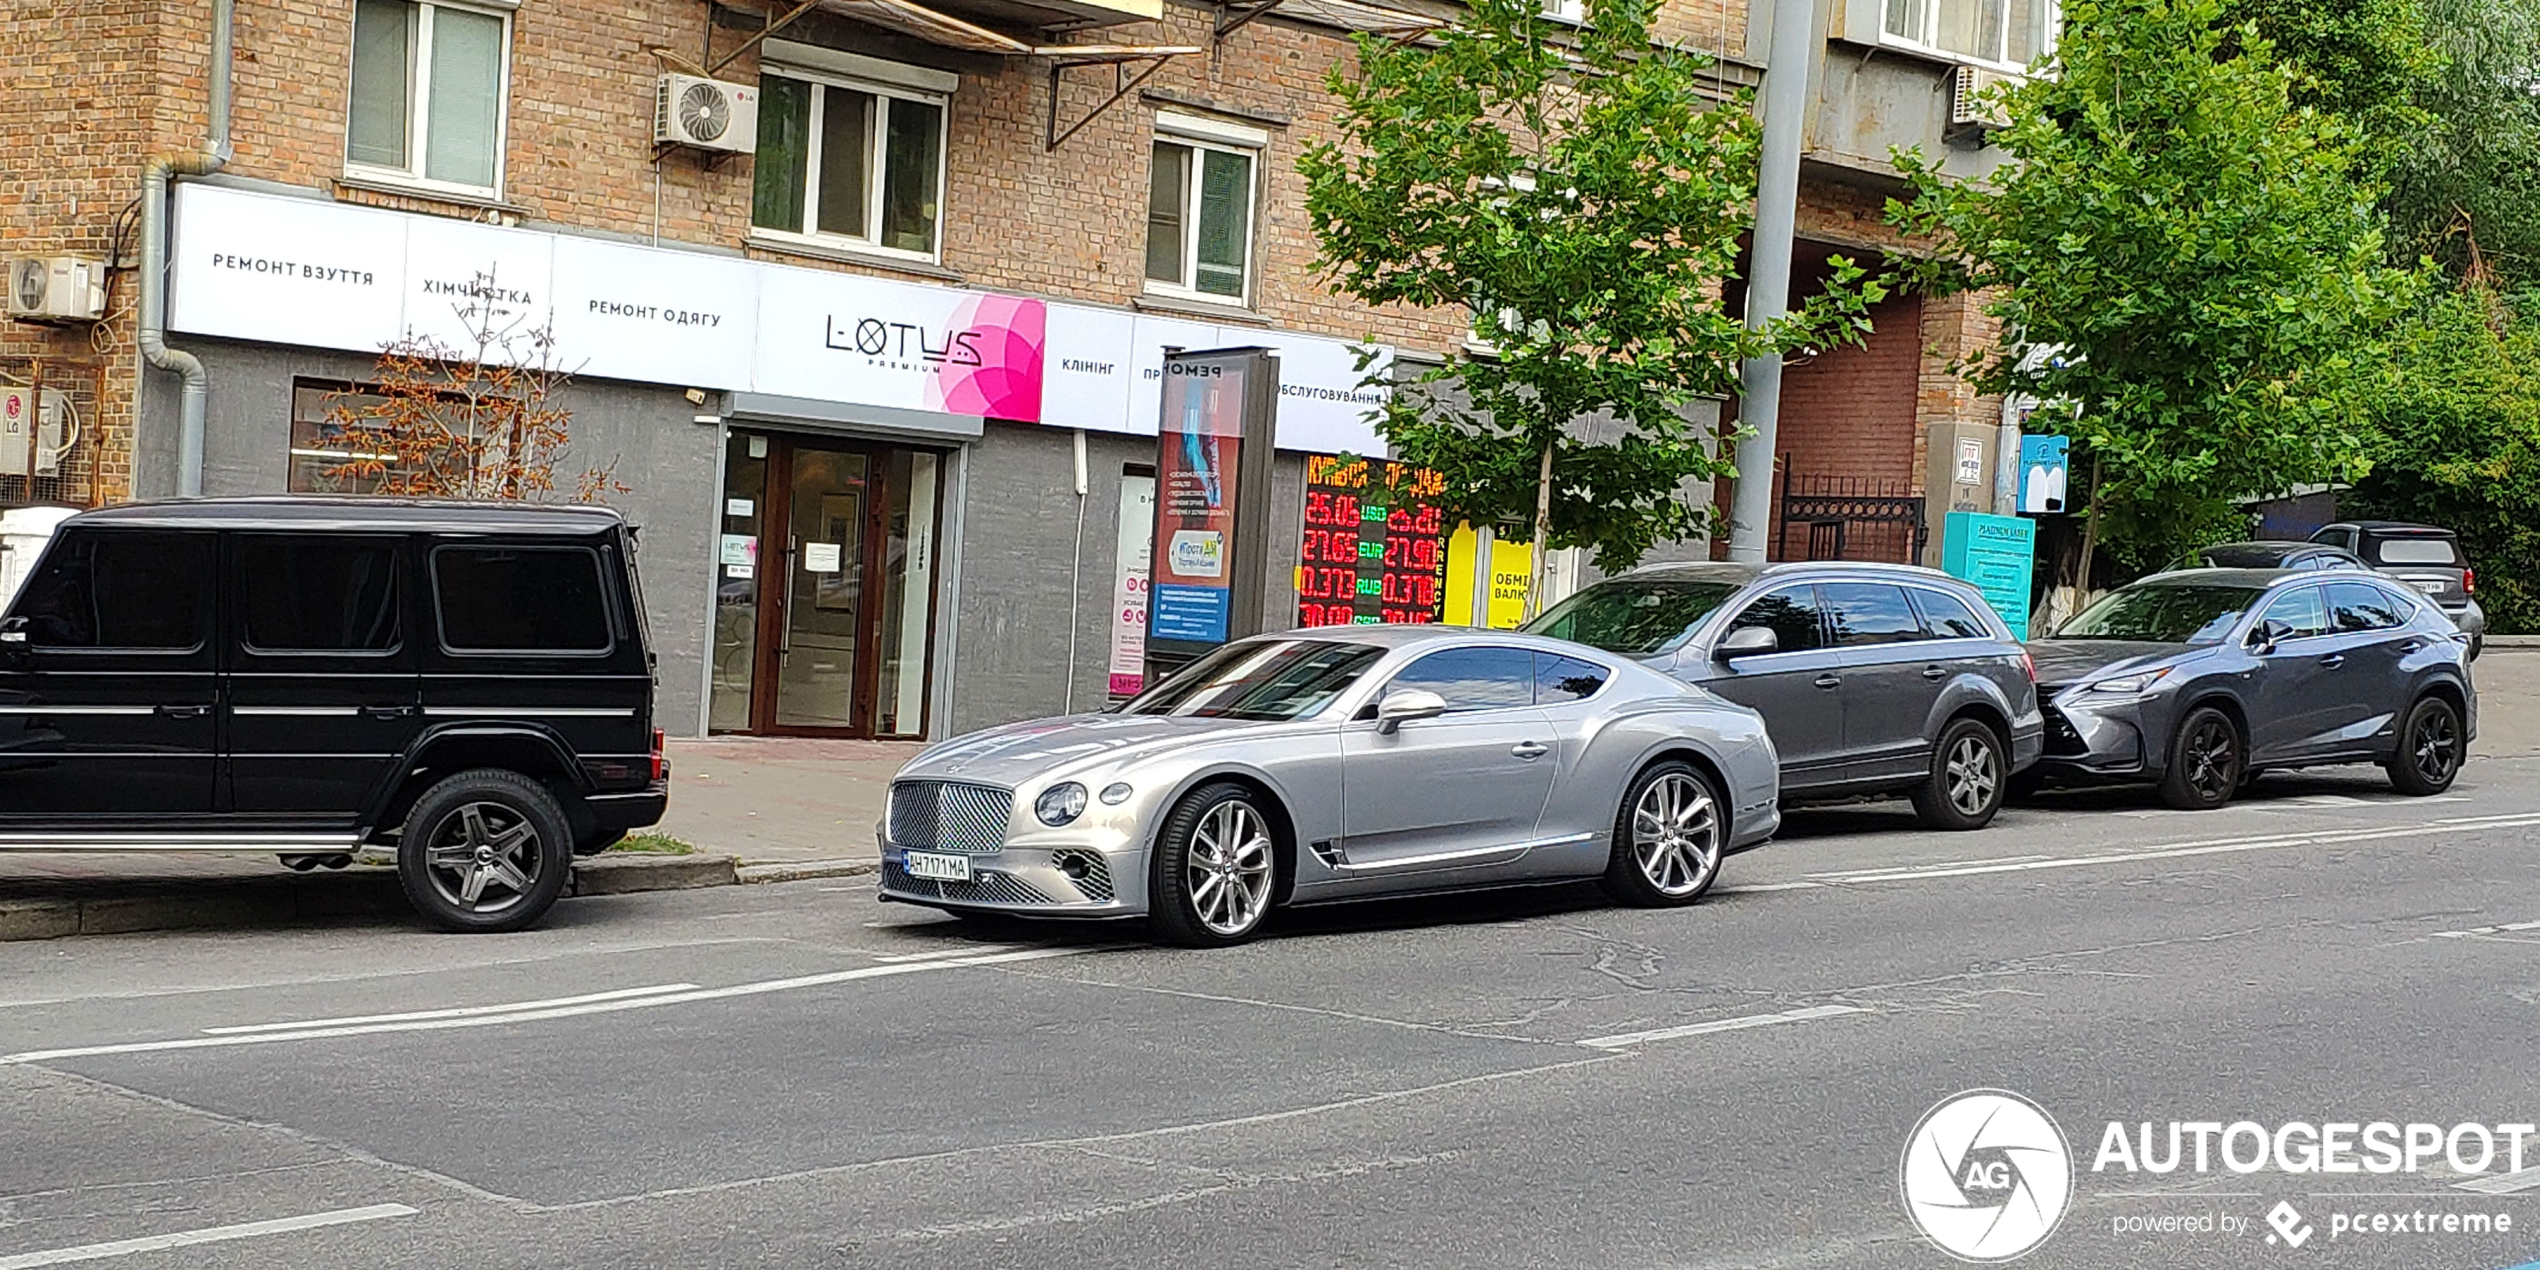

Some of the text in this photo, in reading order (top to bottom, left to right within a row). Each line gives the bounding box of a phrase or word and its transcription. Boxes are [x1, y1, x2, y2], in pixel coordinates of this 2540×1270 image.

[213, 253, 373, 285] РЕМОНТ ВЗУТТЯ
[423, 279, 531, 304] ХІМЧИТКА
[589, 299, 722, 327] РЕМОНТ ОДЯГУ
[826, 314, 982, 367] LOTUS
[868, 359, 941, 374] PREMIUM
[1062, 358, 1115, 376] КЛІНІНГ
[1143, 368, 1382, 406] ПР БСЛУГОВУВАННЯ
[6, 421, 19, 434] LG
[1306, 491, 1360, 527] 25.05
[1361, 505, 1387, 521] USD
[1303, 529, 1438, 570] 27.65 EUR 27.90
[1301, 565, 1436, 606] 0.373 RUB 0.378
[1433, 536, 1446, 617] RRENCY
[1496, 573, 1529, 587] ОБМІ
[1495, 588, 1529, 601] ВАЛЮ
